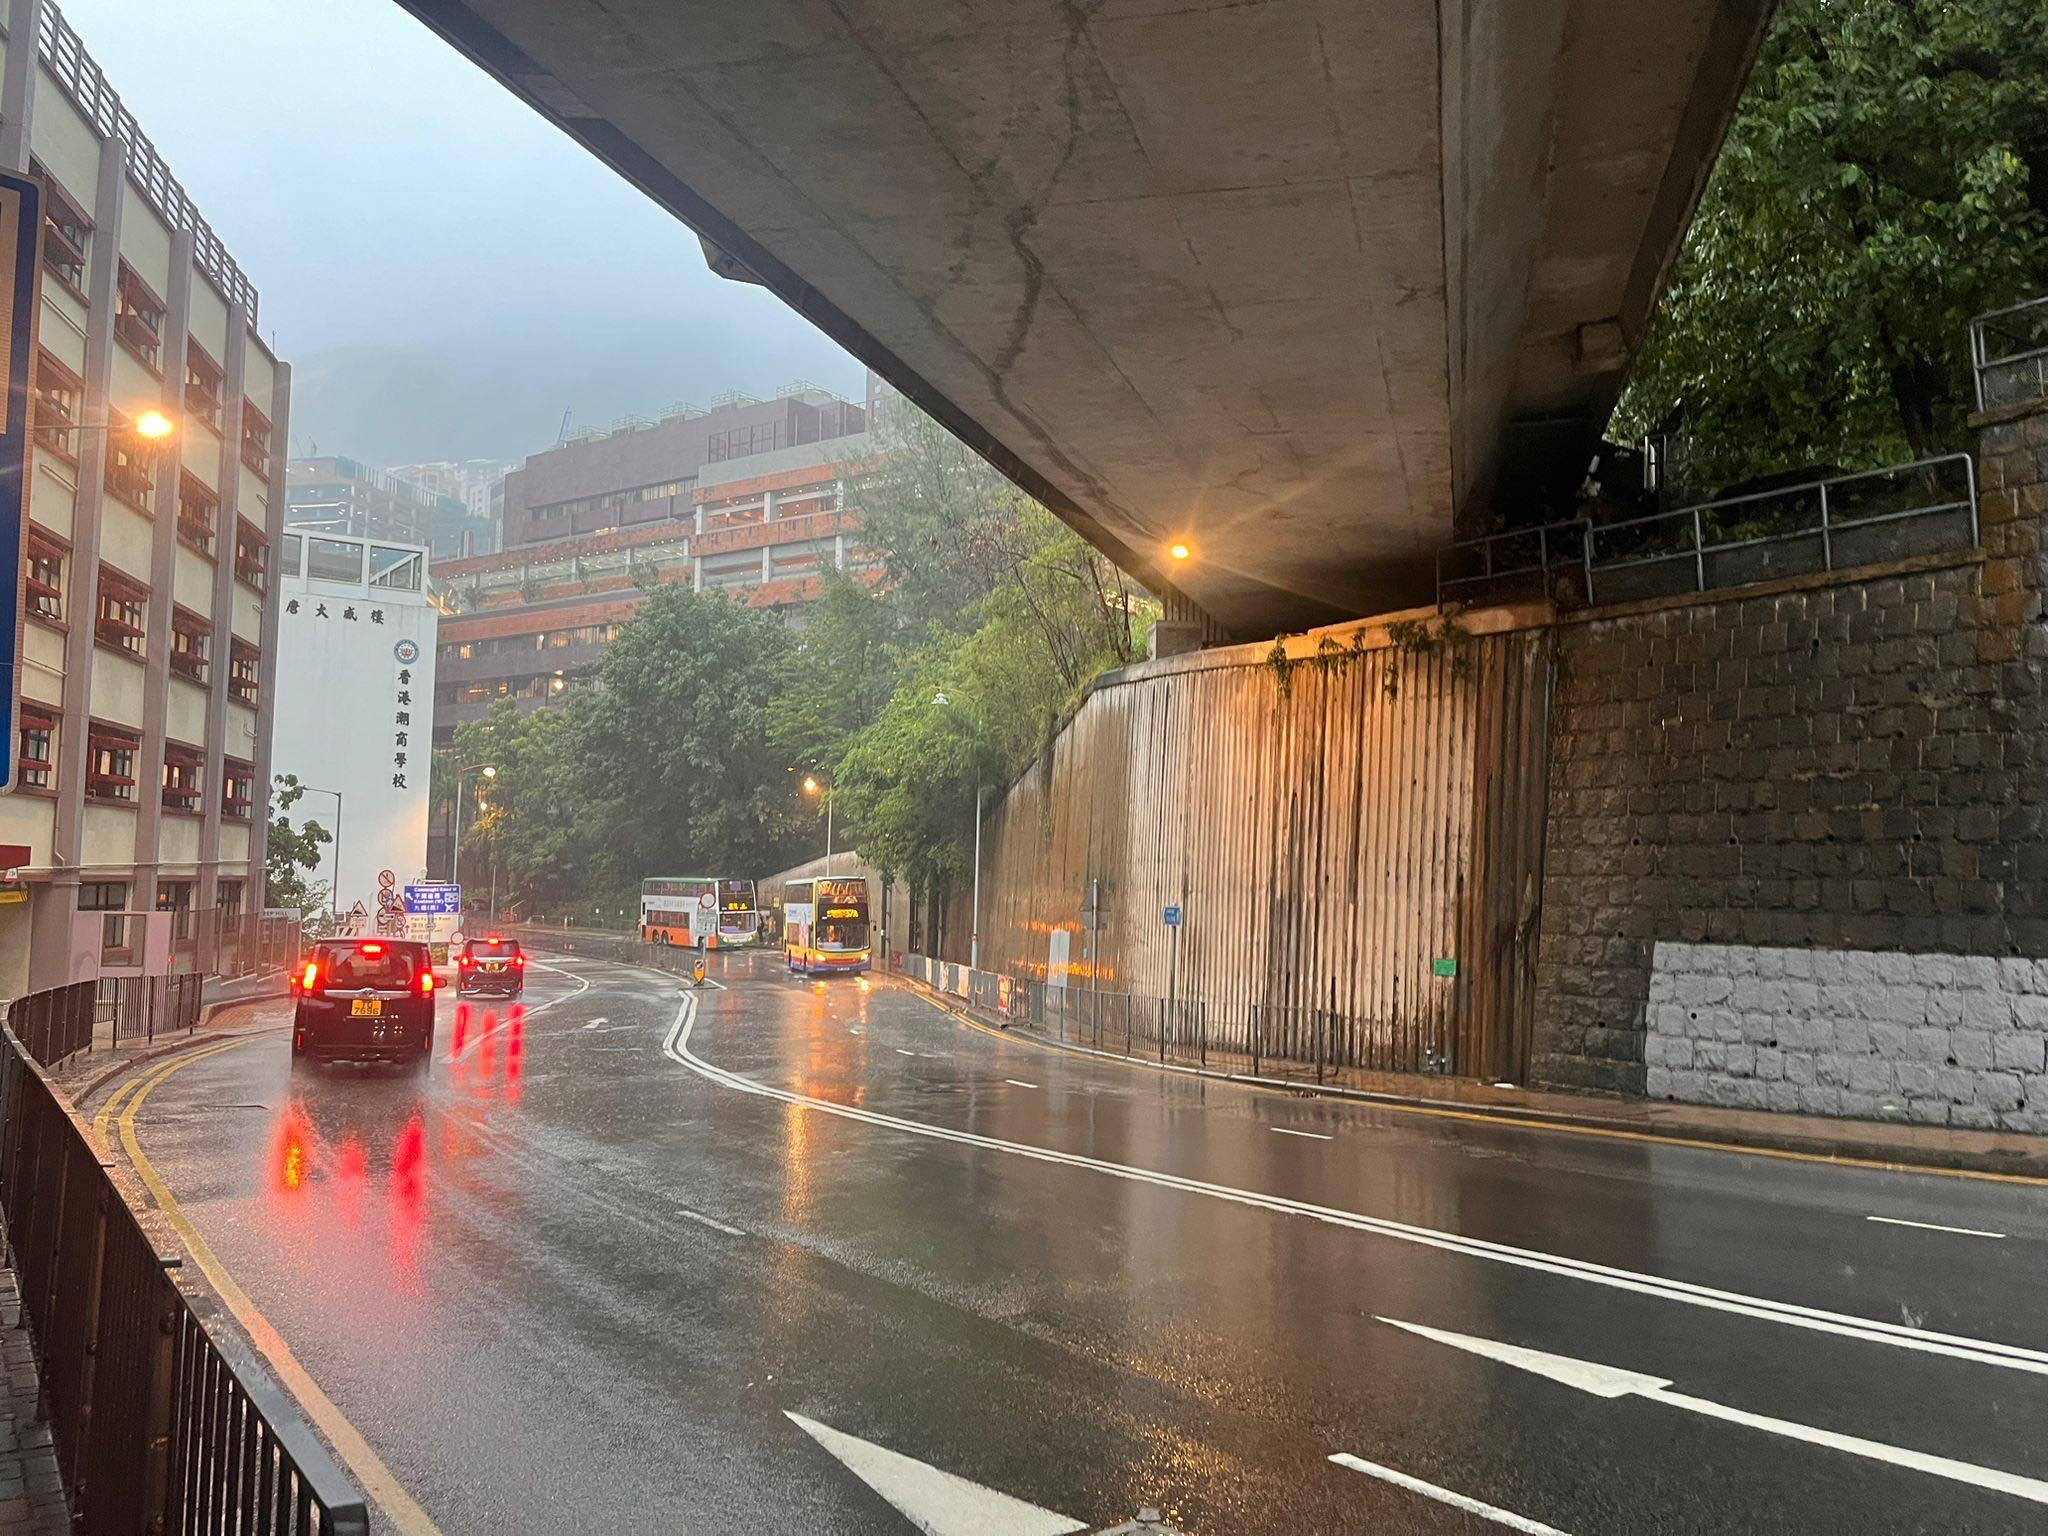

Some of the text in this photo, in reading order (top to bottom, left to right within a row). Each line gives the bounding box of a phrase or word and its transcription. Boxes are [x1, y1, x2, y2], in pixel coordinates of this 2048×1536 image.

[392, 669, 412, 790] 香港潮商學校
